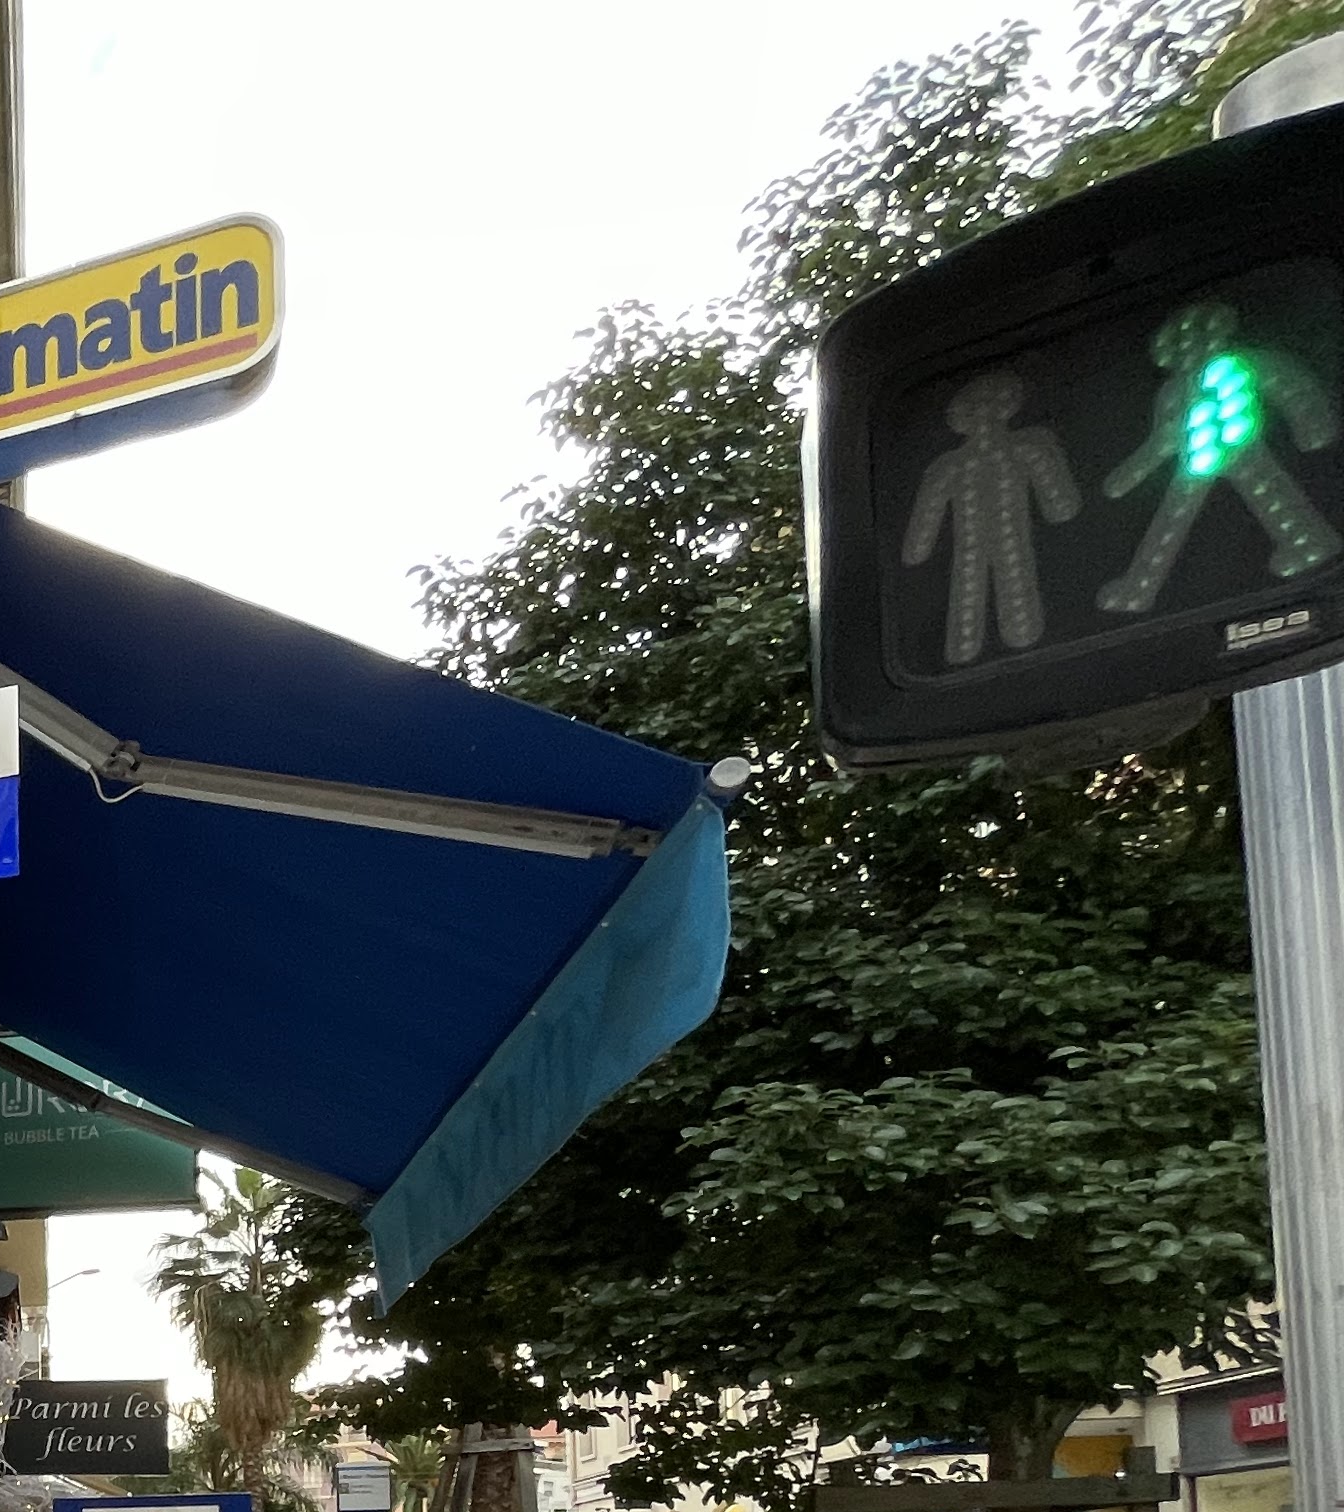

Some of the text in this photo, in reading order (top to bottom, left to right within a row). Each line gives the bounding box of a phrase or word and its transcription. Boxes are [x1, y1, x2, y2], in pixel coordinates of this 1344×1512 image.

[3, 1124, 100, 1146] BUBBLE TEA
[10, 1391, 165, 1421] Parmi les
[36, 1427, 138, 1460] fleurs
